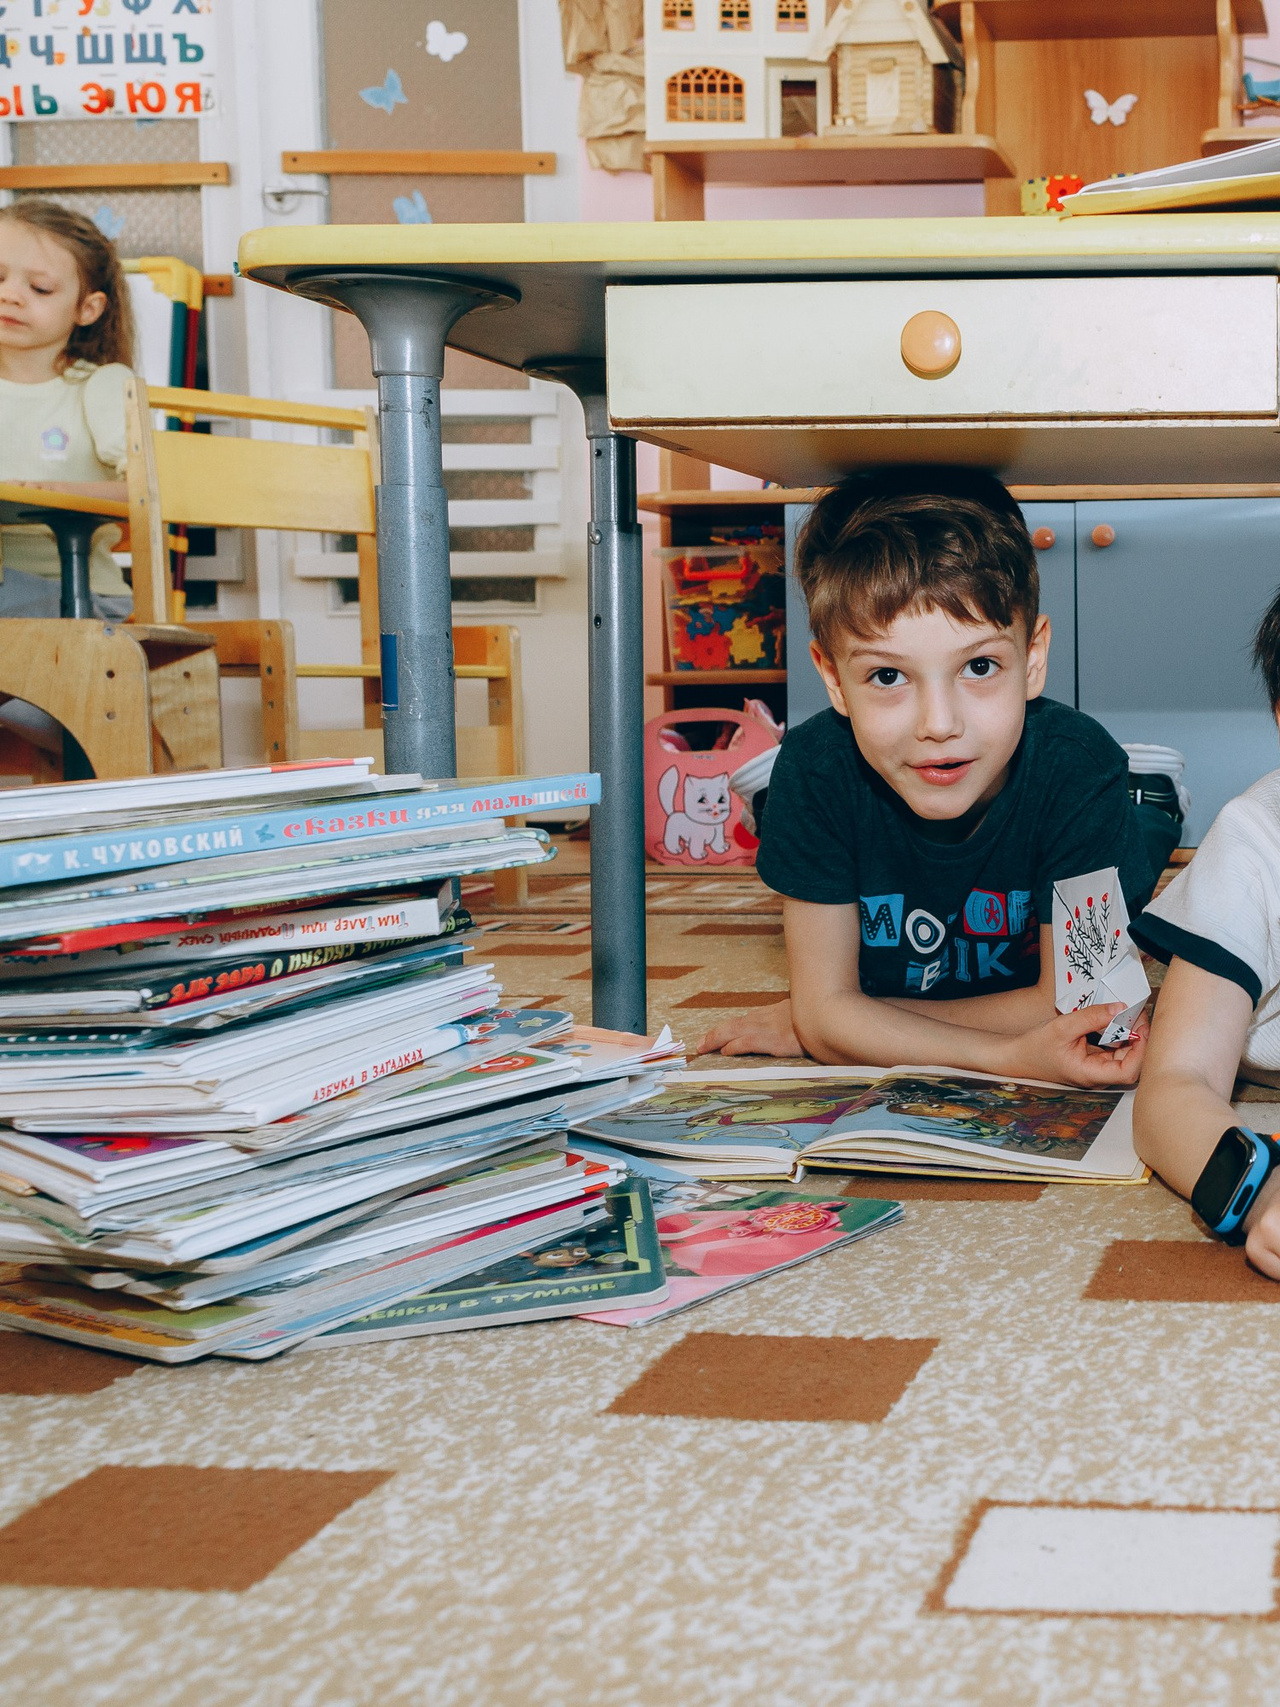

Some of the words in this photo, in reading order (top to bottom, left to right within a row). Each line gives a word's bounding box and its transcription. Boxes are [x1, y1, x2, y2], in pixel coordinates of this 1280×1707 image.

[92, 825, 244, 865] ЧУКОВСКИЙ
[283, 807, 411, 839] сказки
[313, 1075, 356, 1101] АЗБУКА
[373, 1048, 424, 1079] ЗАГАДКАХ
[491, 1280, 617, 1304] ТУМАНЕ
